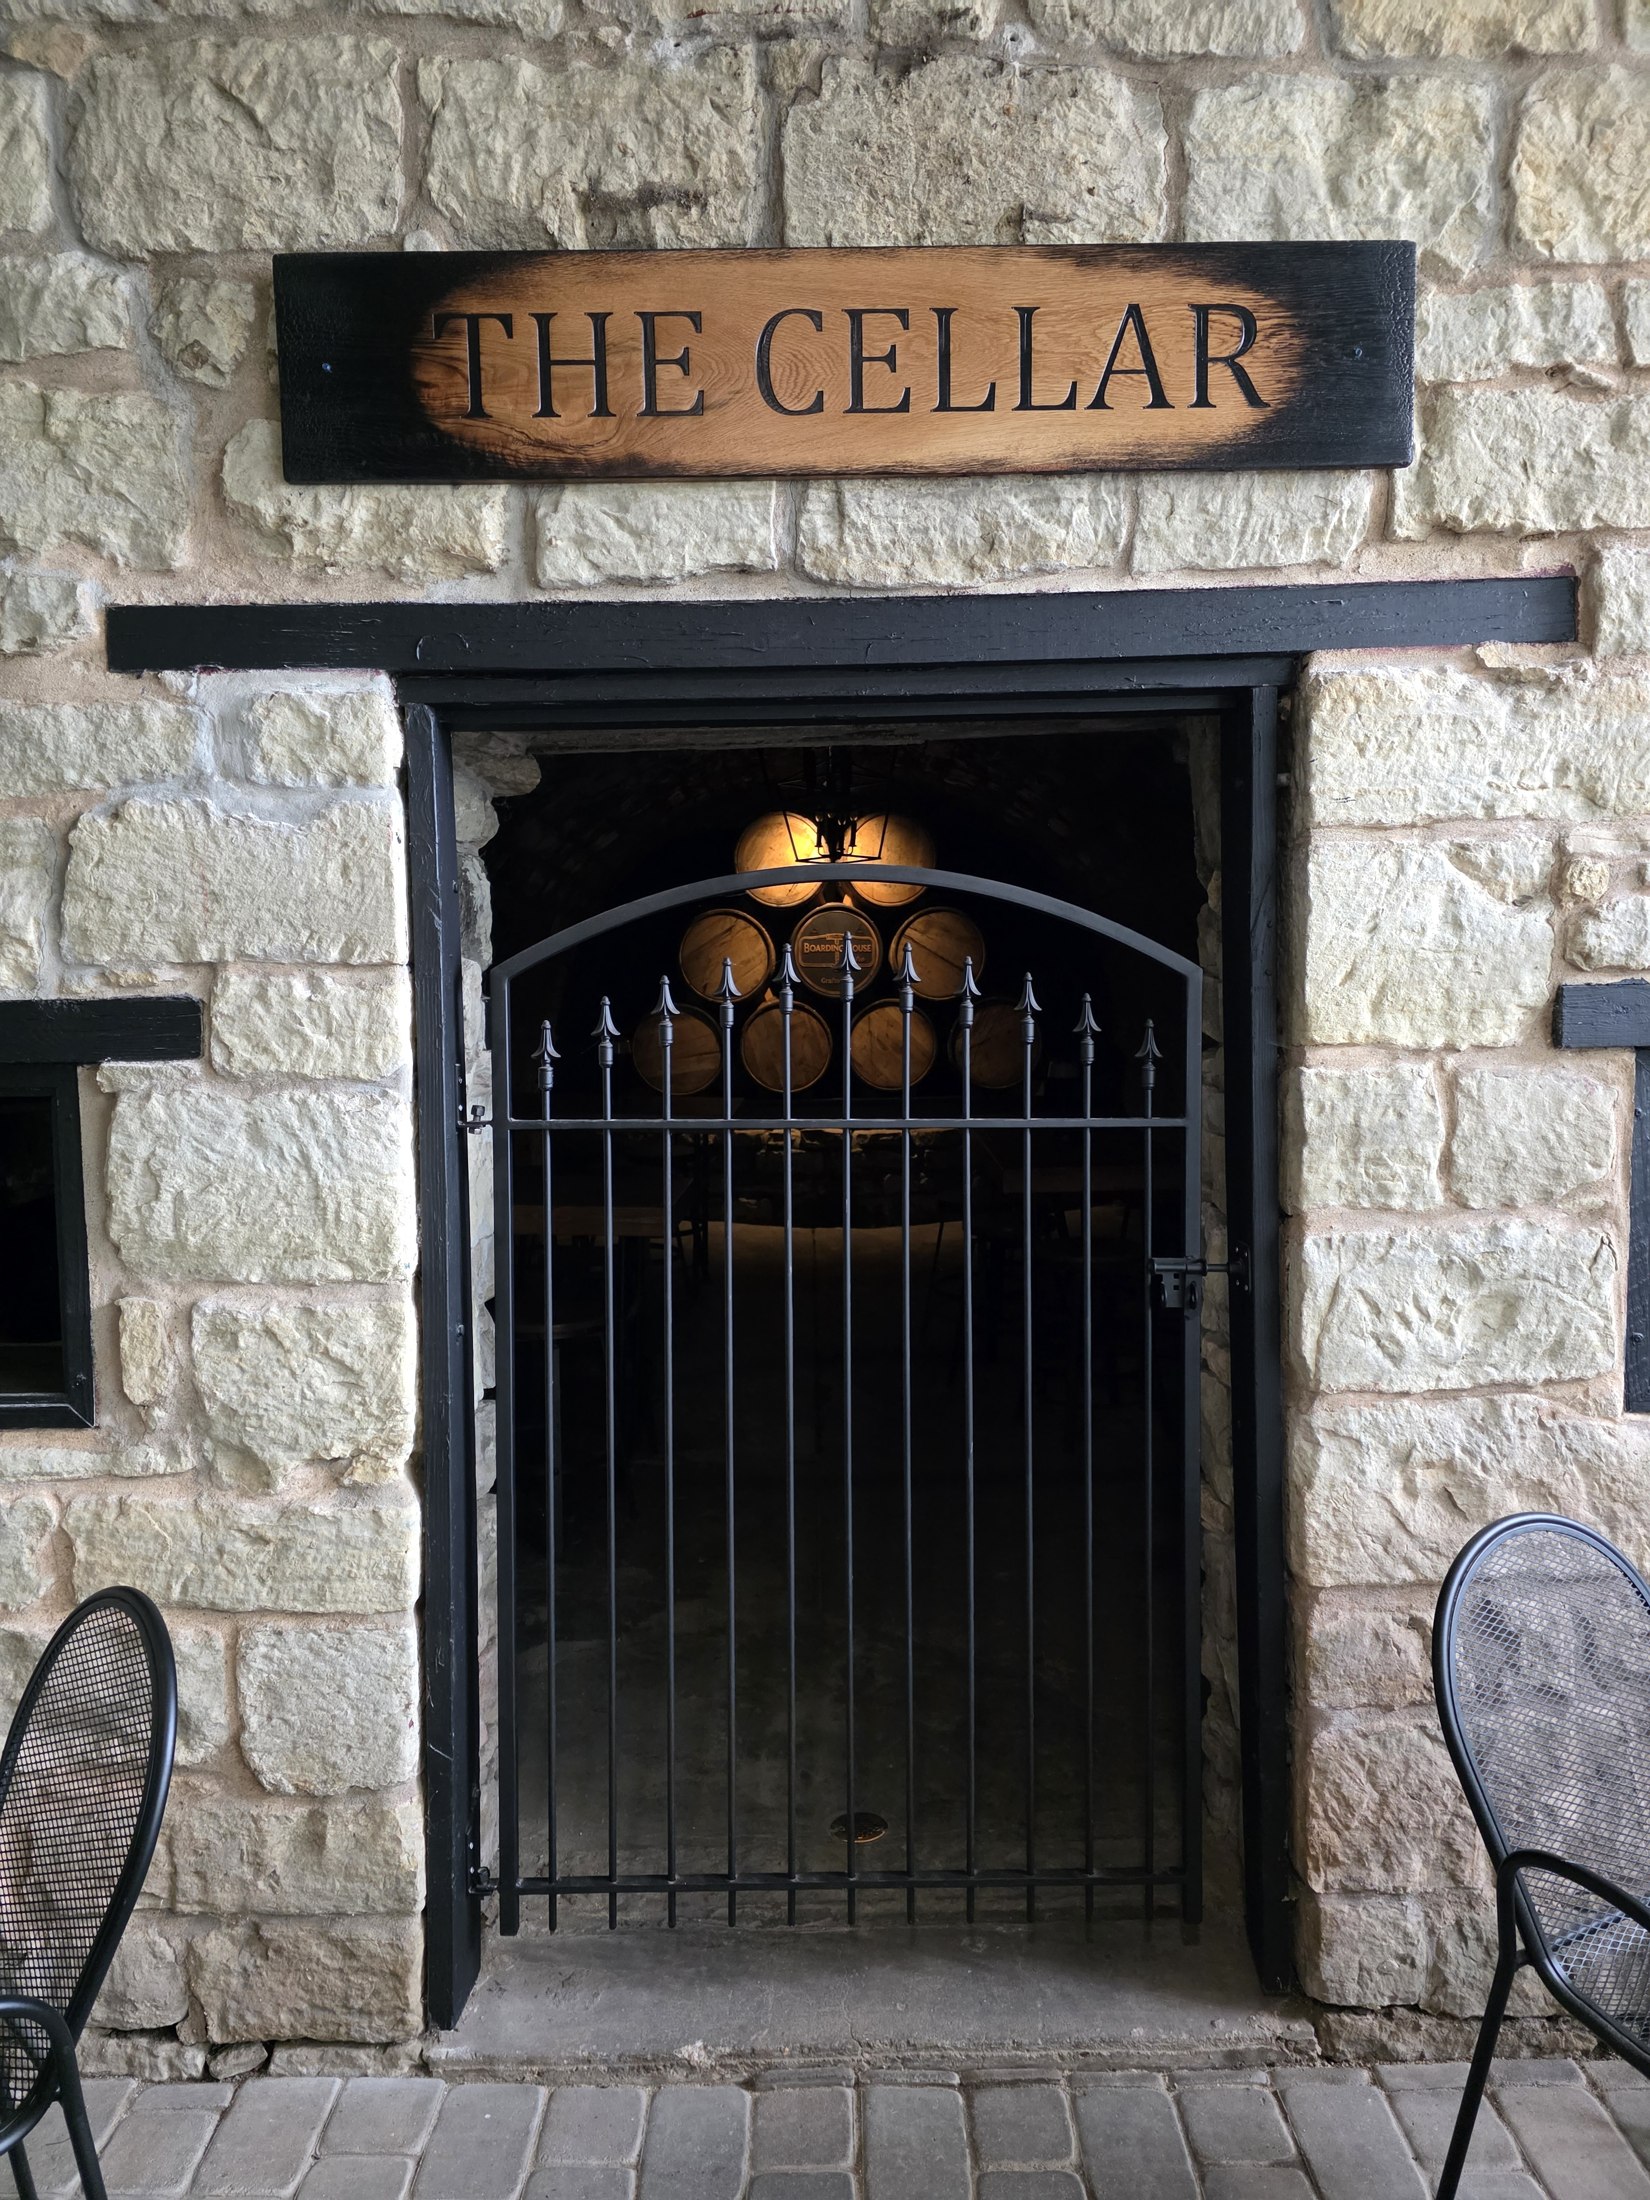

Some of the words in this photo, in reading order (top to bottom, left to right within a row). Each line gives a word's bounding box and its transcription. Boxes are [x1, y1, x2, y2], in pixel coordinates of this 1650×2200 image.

[431, 311, 706, 420] THE
[755, 302, 1271, 417] CELLAR
[849, 943, 872, 953] OUSE
